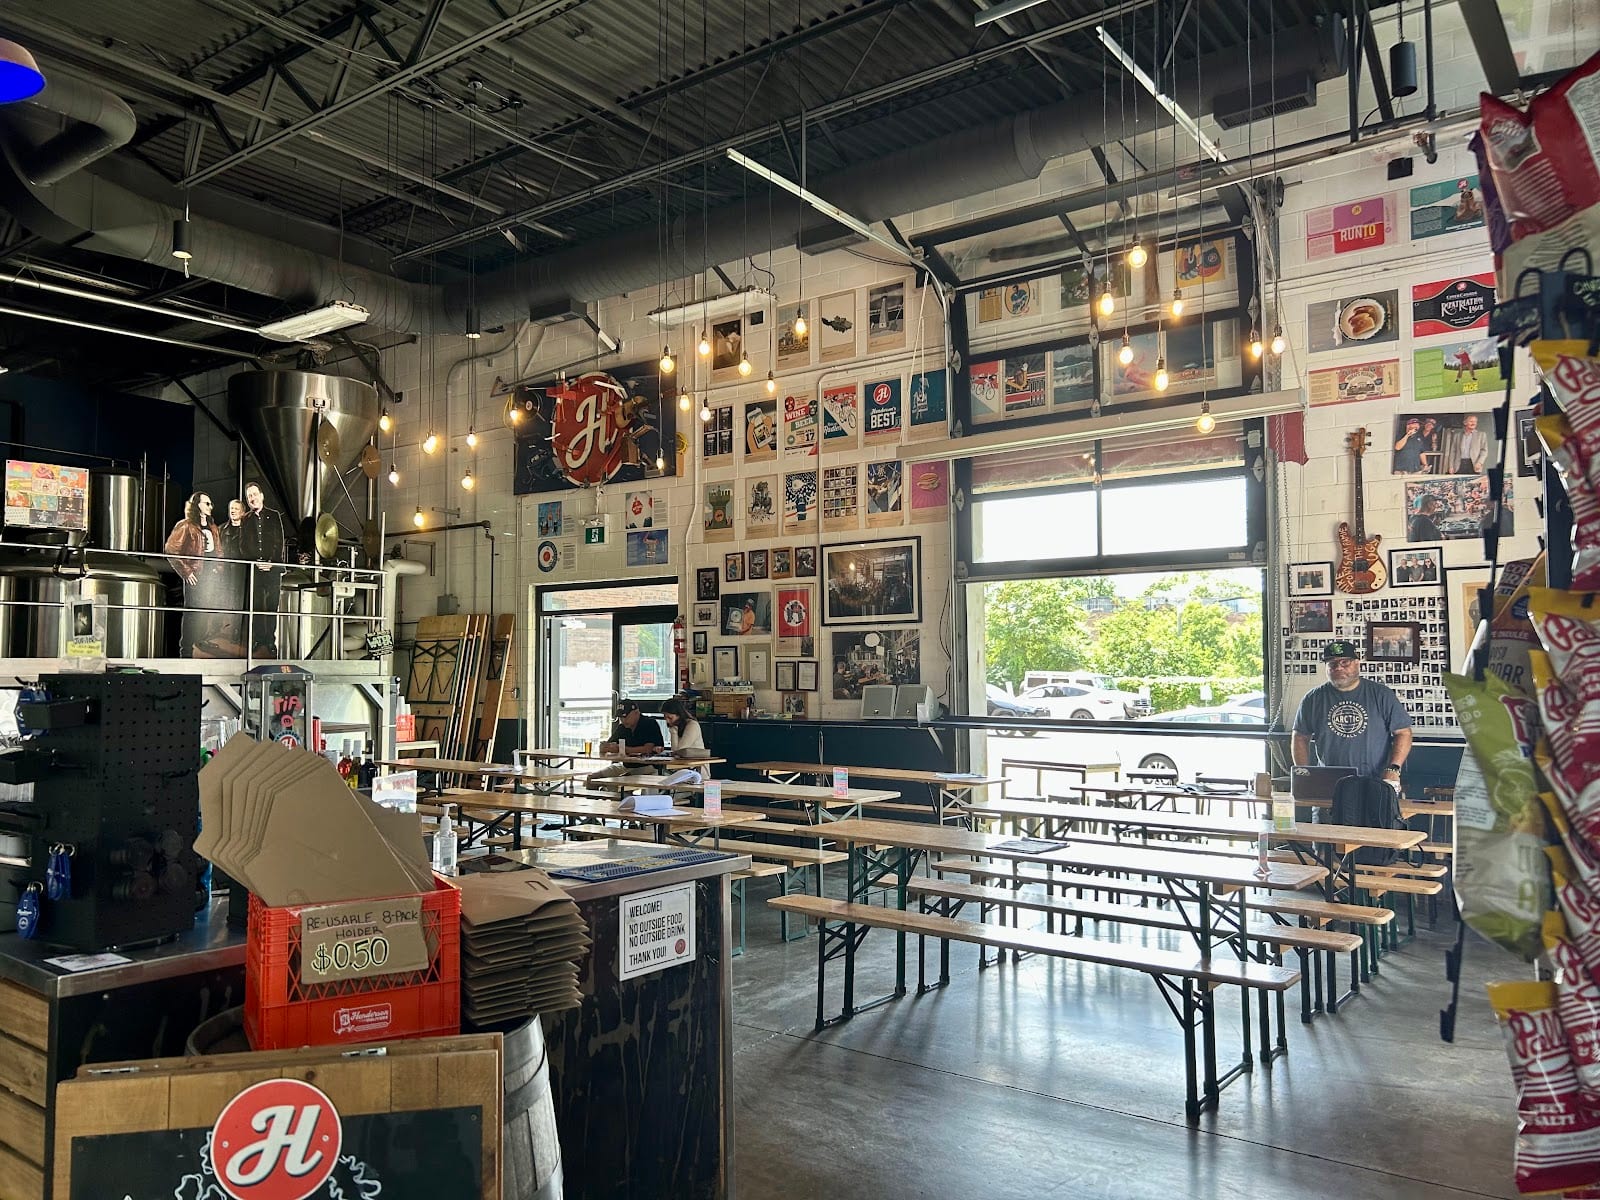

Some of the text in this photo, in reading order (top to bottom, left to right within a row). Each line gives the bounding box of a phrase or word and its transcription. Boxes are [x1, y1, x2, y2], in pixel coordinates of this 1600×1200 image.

[785, 408, 806, 420] WINE
[795, 417, 814, 429] BEER
[870, 411, 897, 429] BEST
[805, 432, 815, 441] 17
[1335, 715, 1360, 723] ARCTIC
[629, 900, 663, 918] WELCOME!
[307, 910, 418, 931] RE-USABLE 8-PACK
[629, 912, 682, 936] NO OUTSIDE FOOD
[629, 924, 686, 948] NO OUTSIDE DRINK
[311, 936, 390, 976] $0.50
[629, 945, 667, 966] THANK YOU!
[225, 1103, 323, 1187] H
